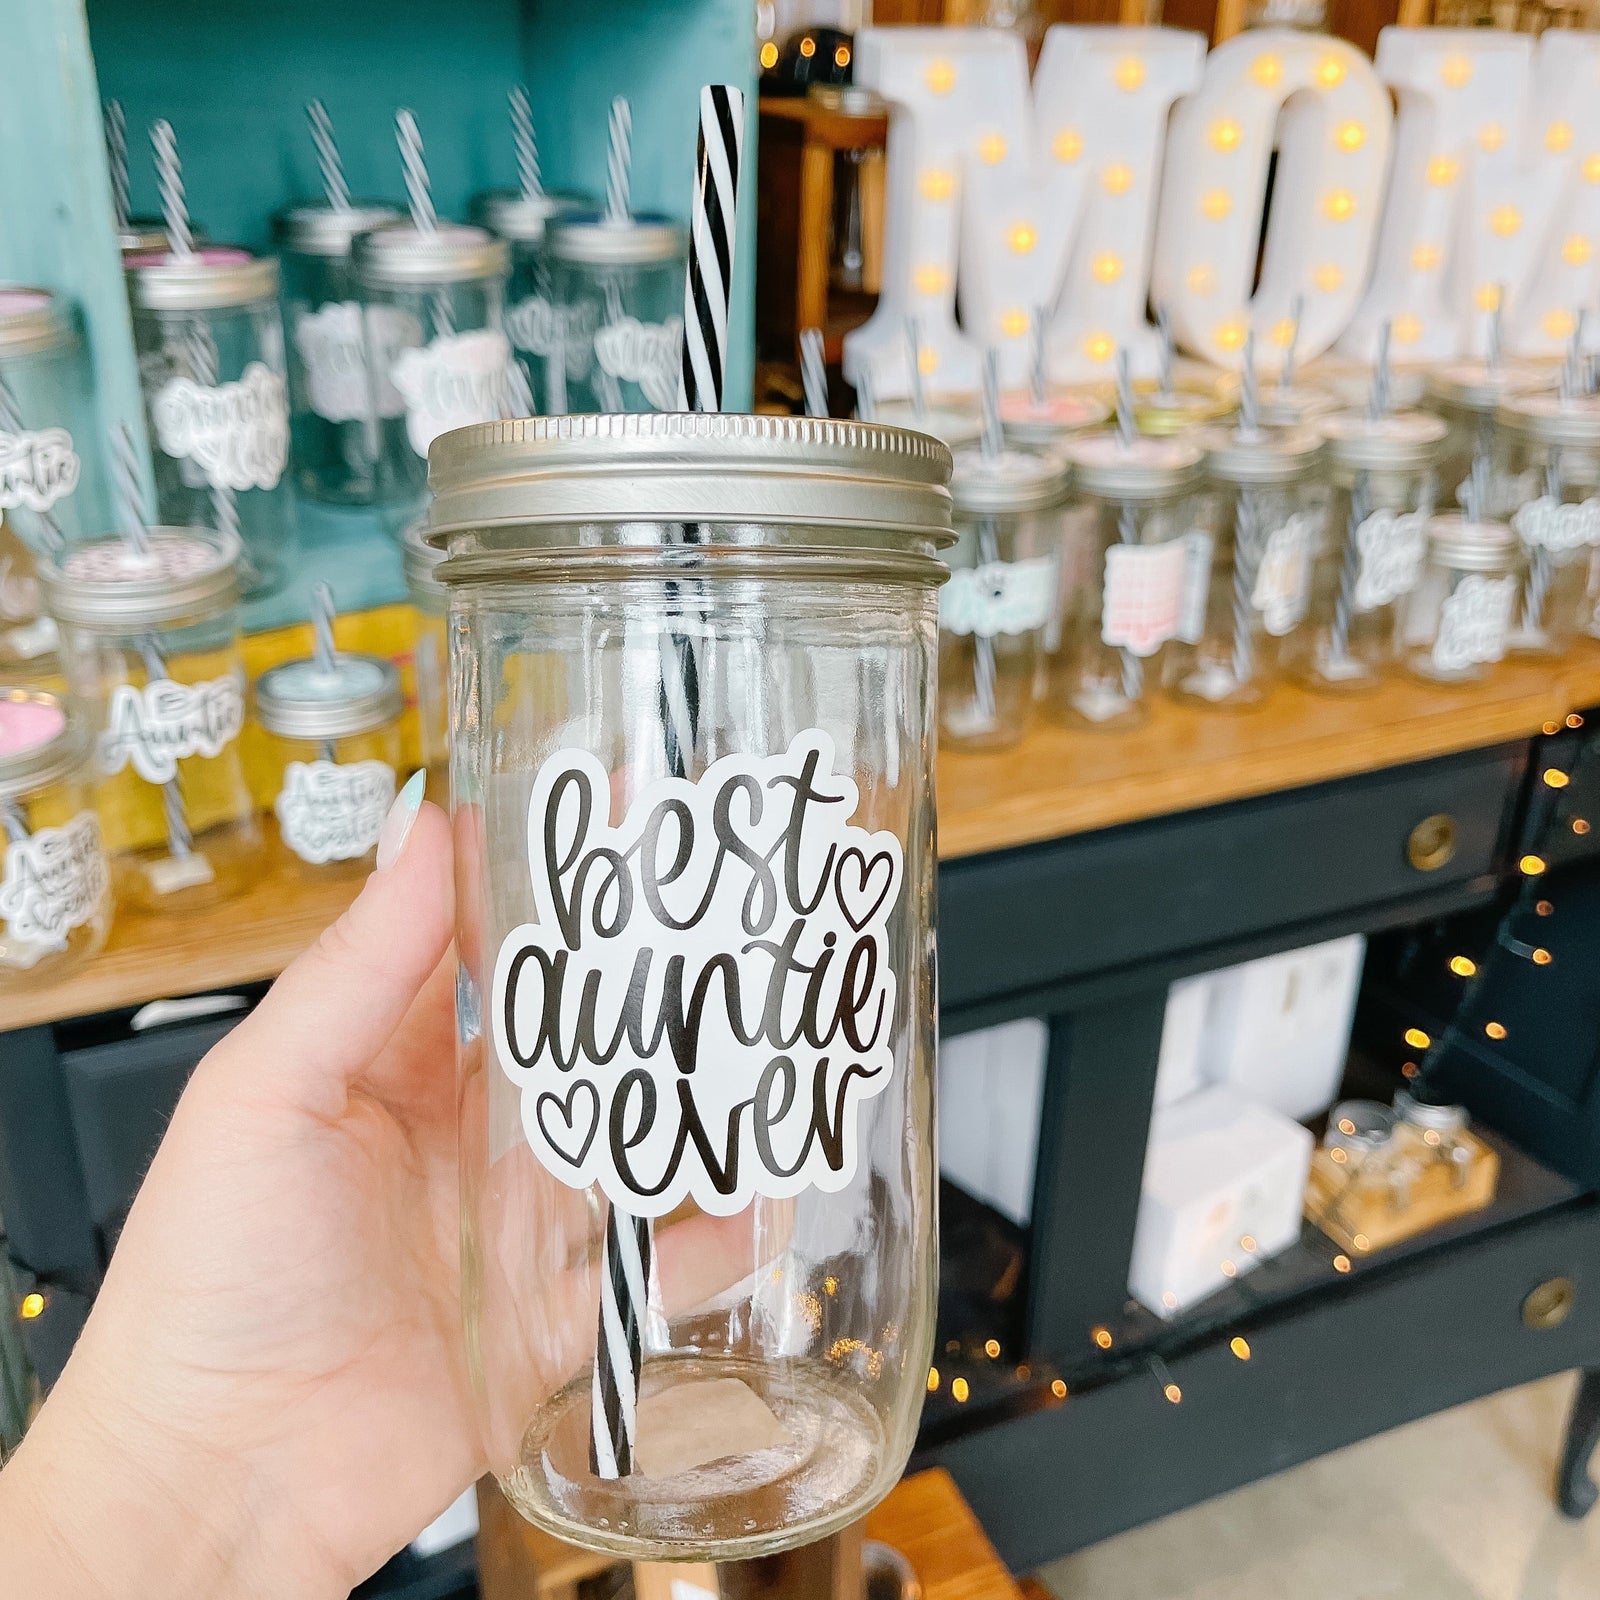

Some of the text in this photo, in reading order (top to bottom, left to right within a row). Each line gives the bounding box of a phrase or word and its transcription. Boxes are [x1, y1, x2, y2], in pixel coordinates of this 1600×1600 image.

[543, 748, 845, 952] best
[504, 918, 886, 1075] auntie
[608, 1054, 883, 1197] ever
